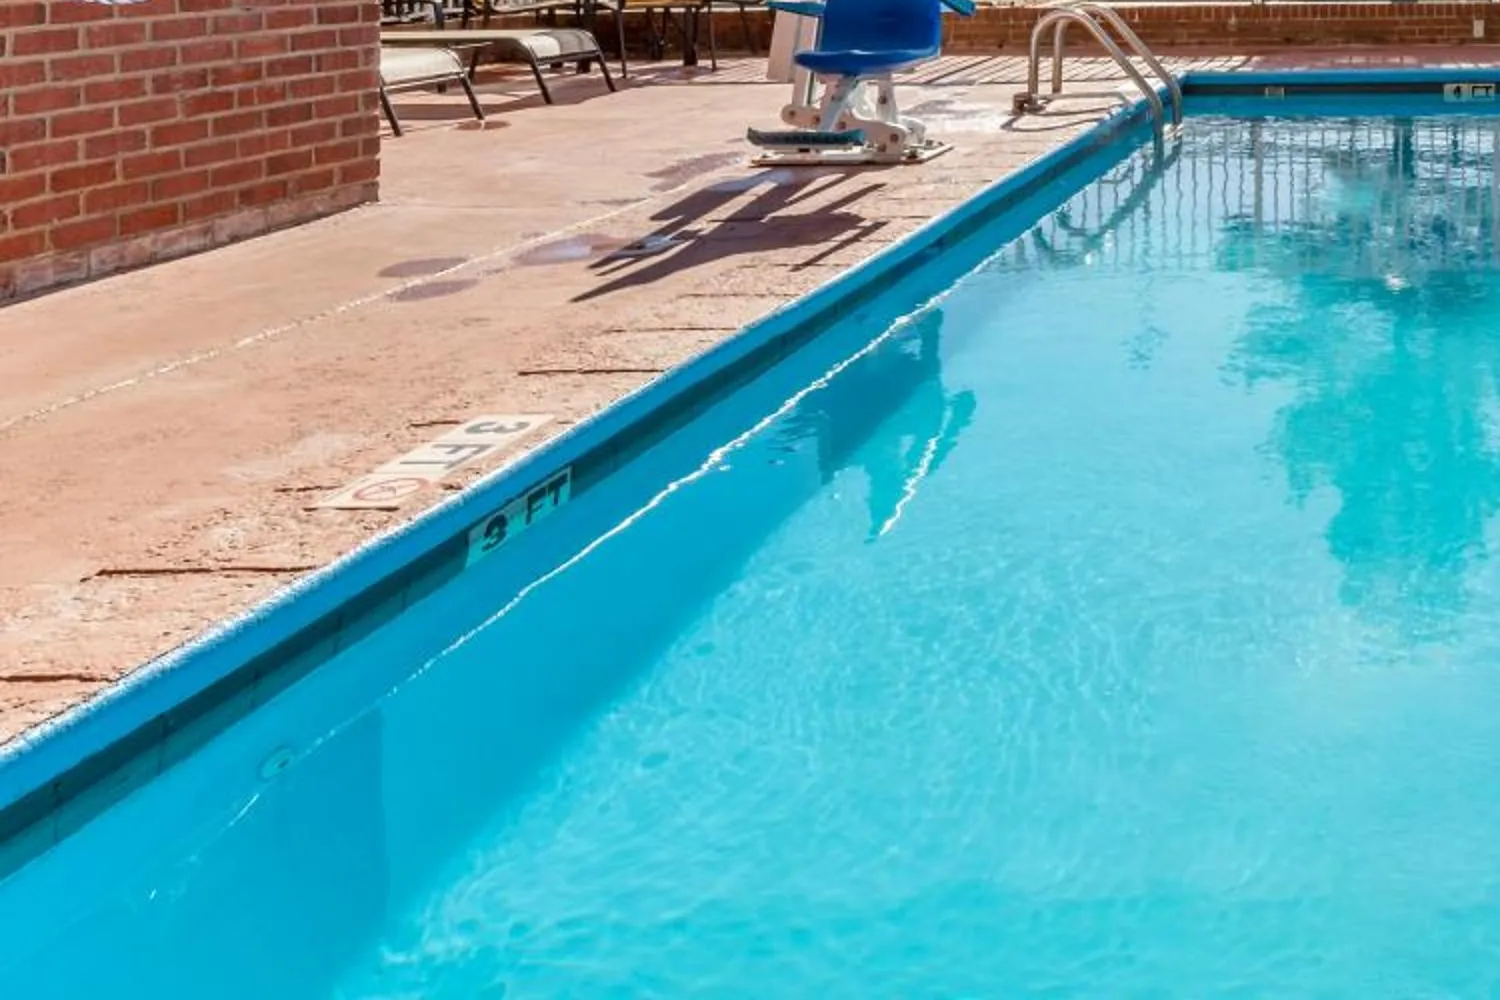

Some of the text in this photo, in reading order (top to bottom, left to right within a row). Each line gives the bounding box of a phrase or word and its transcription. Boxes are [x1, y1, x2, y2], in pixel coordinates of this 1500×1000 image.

[1471, 85, 1493, 99] FT
[399, 421, 530, 470] 3 FT
[482, 474, 569, 552] 3 FT
